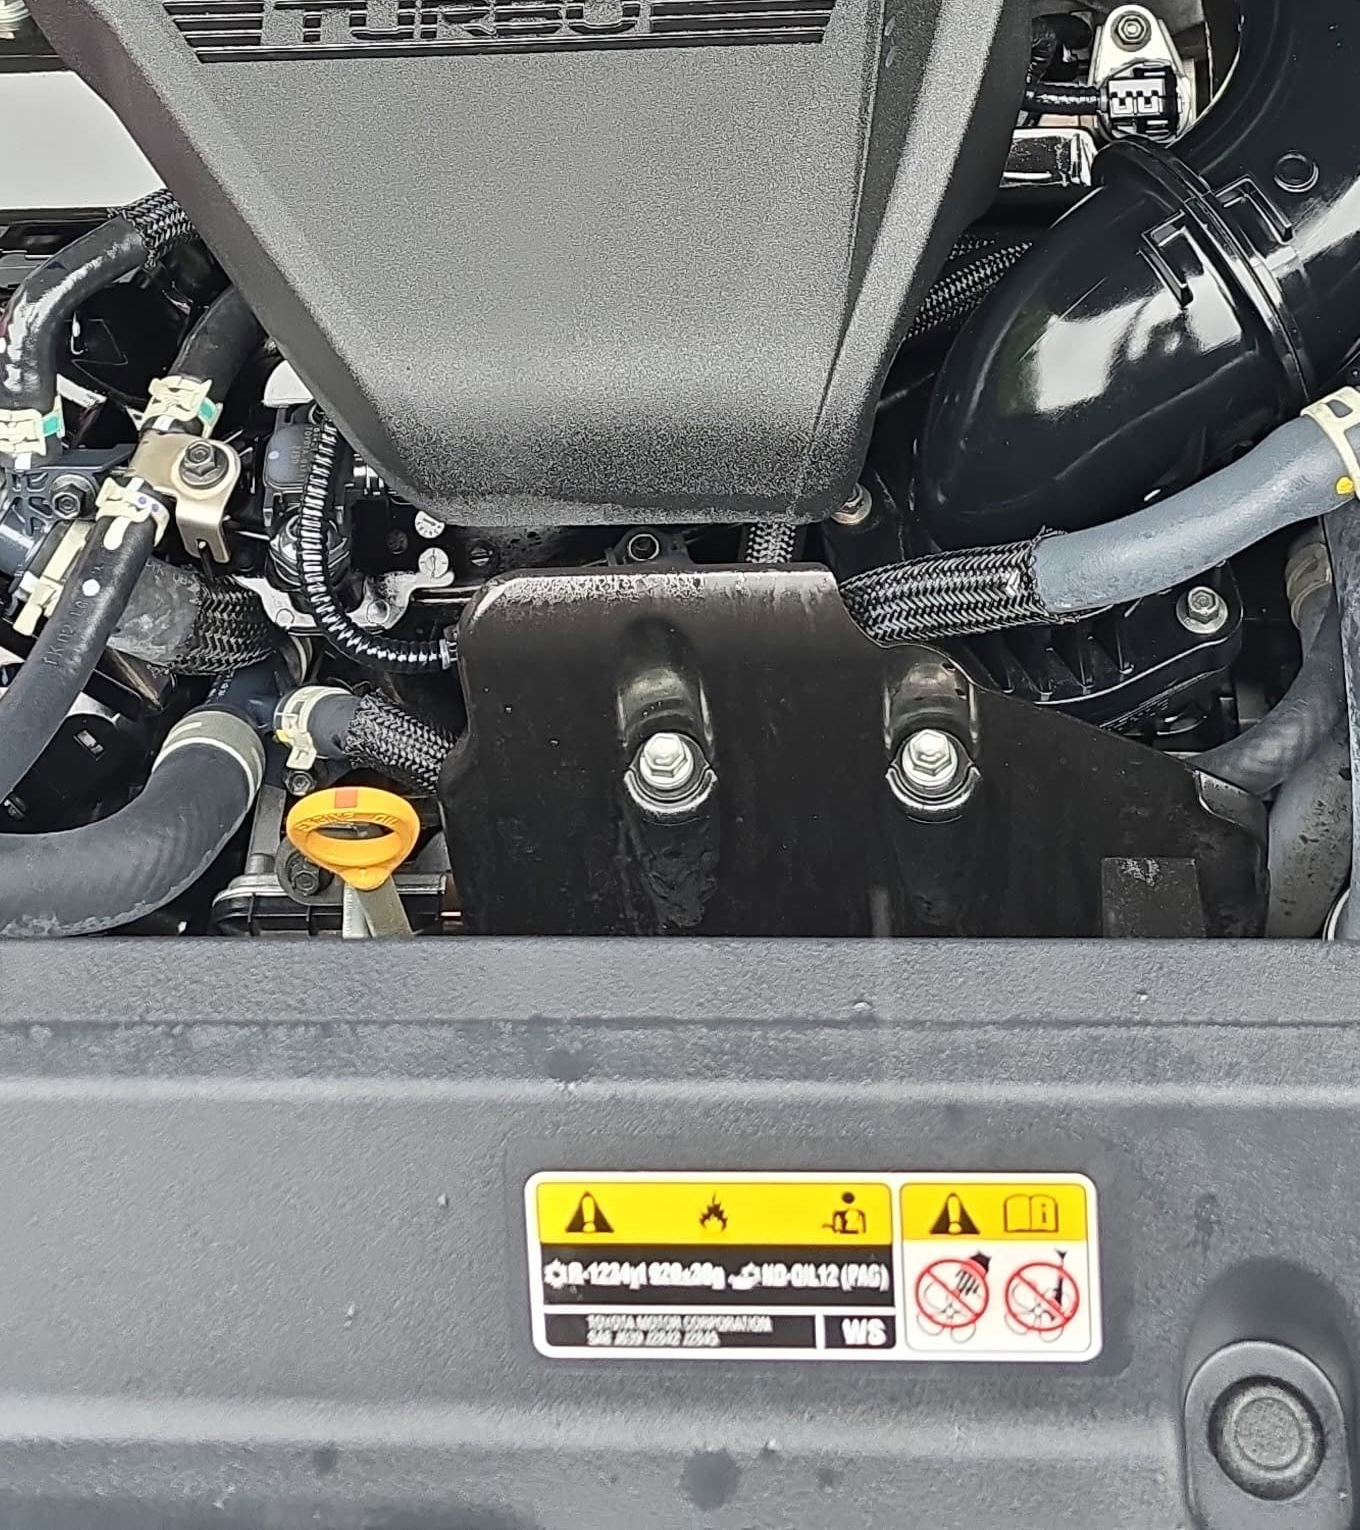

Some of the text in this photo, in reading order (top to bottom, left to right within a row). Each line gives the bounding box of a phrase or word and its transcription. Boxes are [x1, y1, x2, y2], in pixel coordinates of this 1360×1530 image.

[841, 1263, 890, 1292] (PAG)
[586, 1314, 773, 1333] TOYOTA MOTOR CORPORATION
